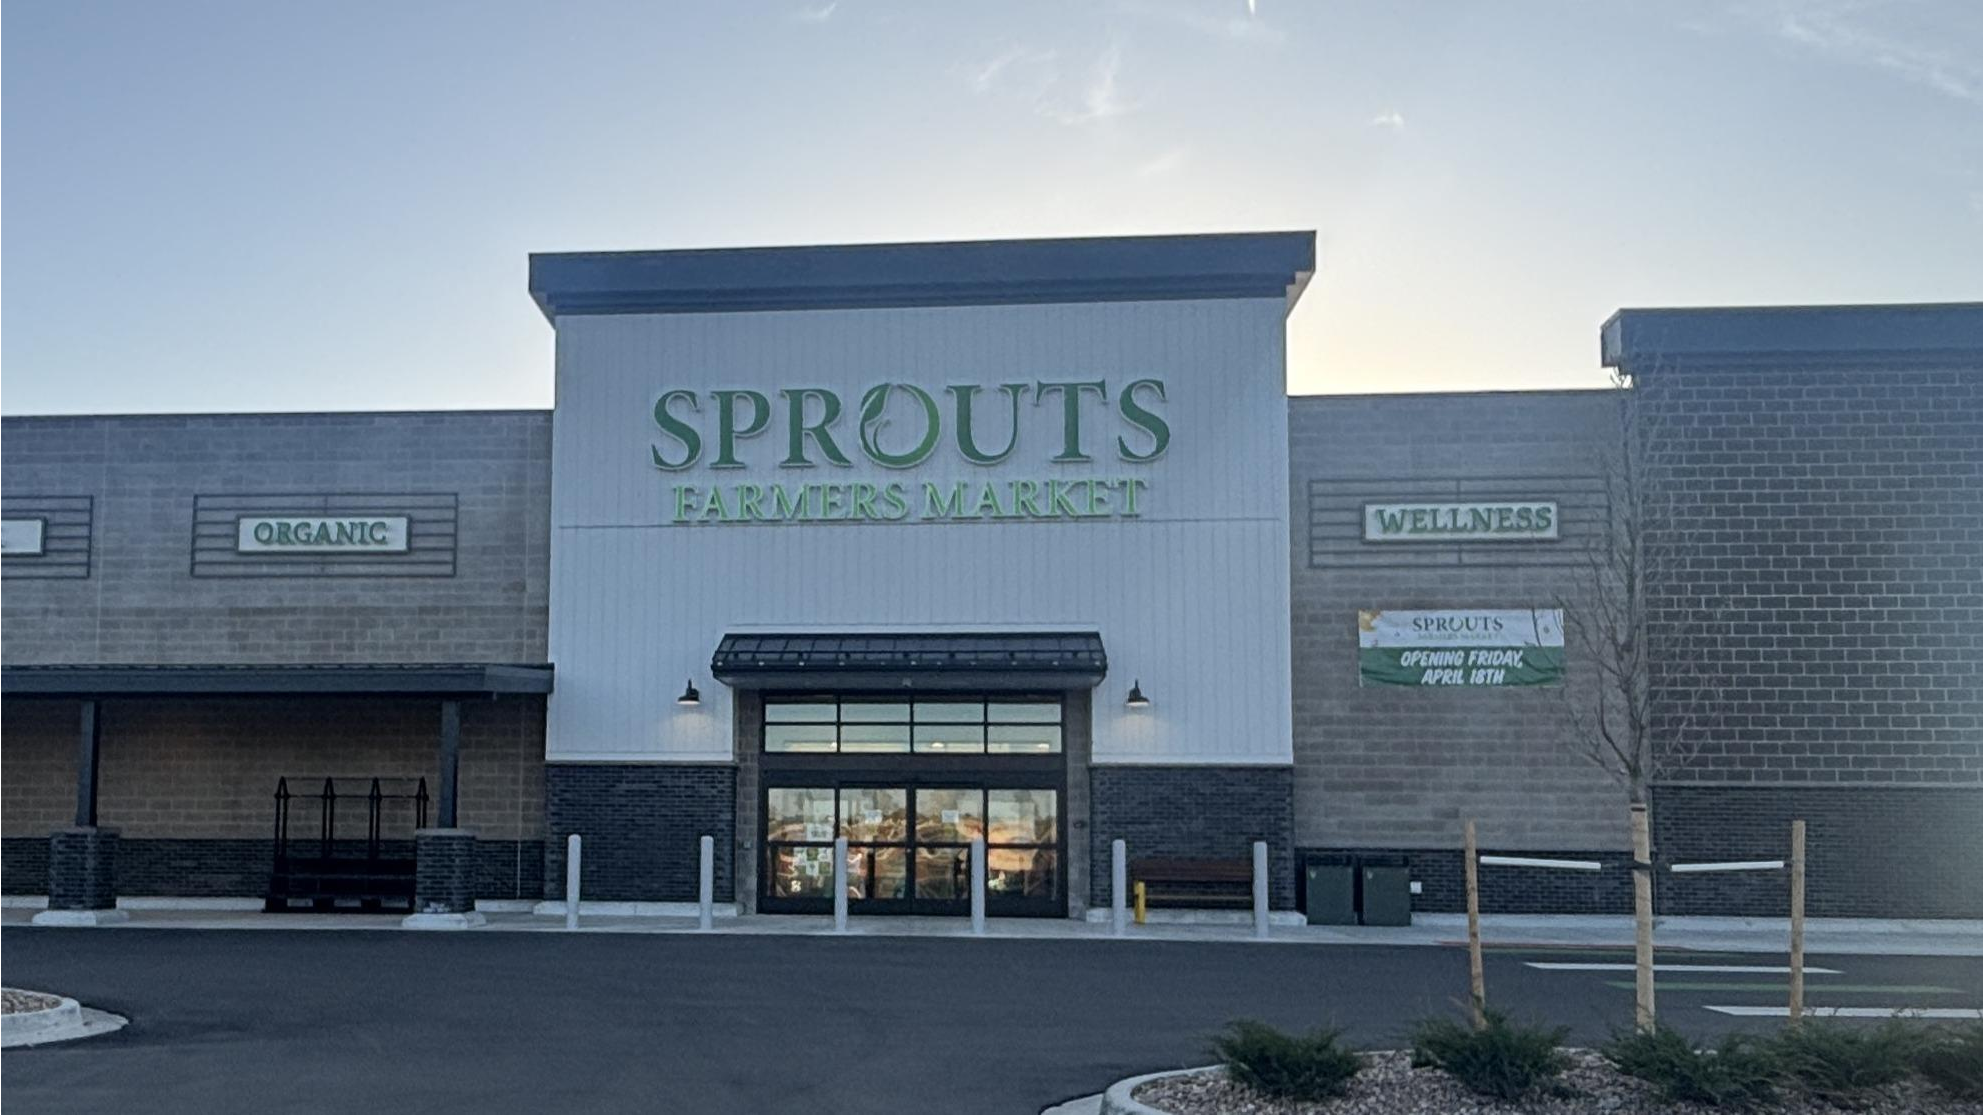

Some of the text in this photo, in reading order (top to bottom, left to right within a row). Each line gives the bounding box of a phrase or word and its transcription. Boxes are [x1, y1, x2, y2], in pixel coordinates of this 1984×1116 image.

[651, 379, 1171, 471] SPROUTS
[672, 478, 1150, 522] FARMERS MARKET
[1376, 506, 1552, 534] WELLNESS
[254, 521, 388, 546] ORGANIC
[1412, 616, 1504, 632] SPROUTS
[1400, 650, 1523, 668] OPENING FRIDAY,
[1421, 668, 1505, 685] APRIL 18TH
